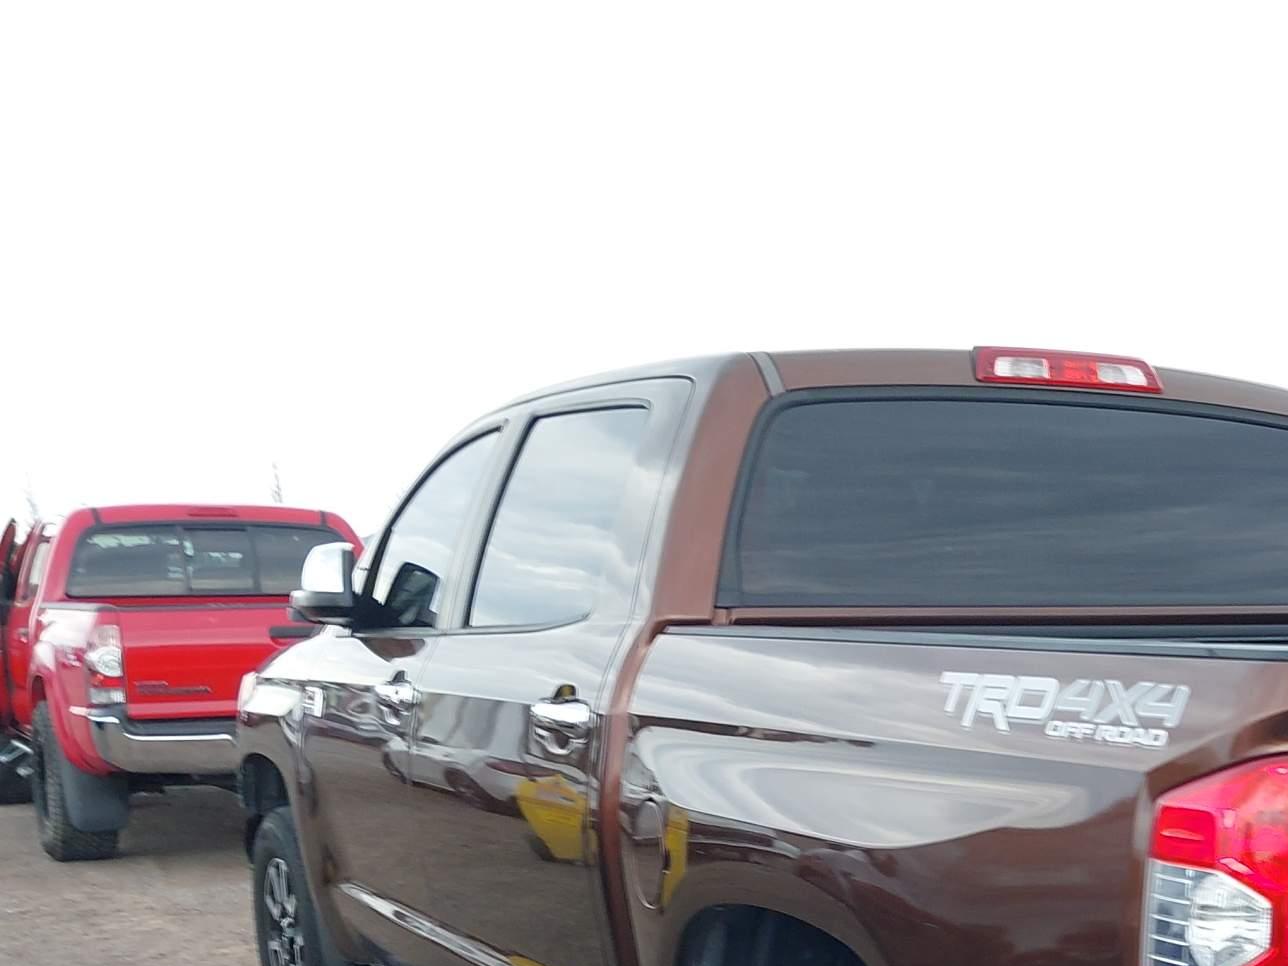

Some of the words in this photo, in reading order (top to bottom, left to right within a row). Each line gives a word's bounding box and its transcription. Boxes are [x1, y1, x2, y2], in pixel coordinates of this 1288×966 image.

[939, 671, 1060, 734] TRD
[1044, 720, 1096, 742] OFF
[1094, 725, 1169, 748] ROAD
